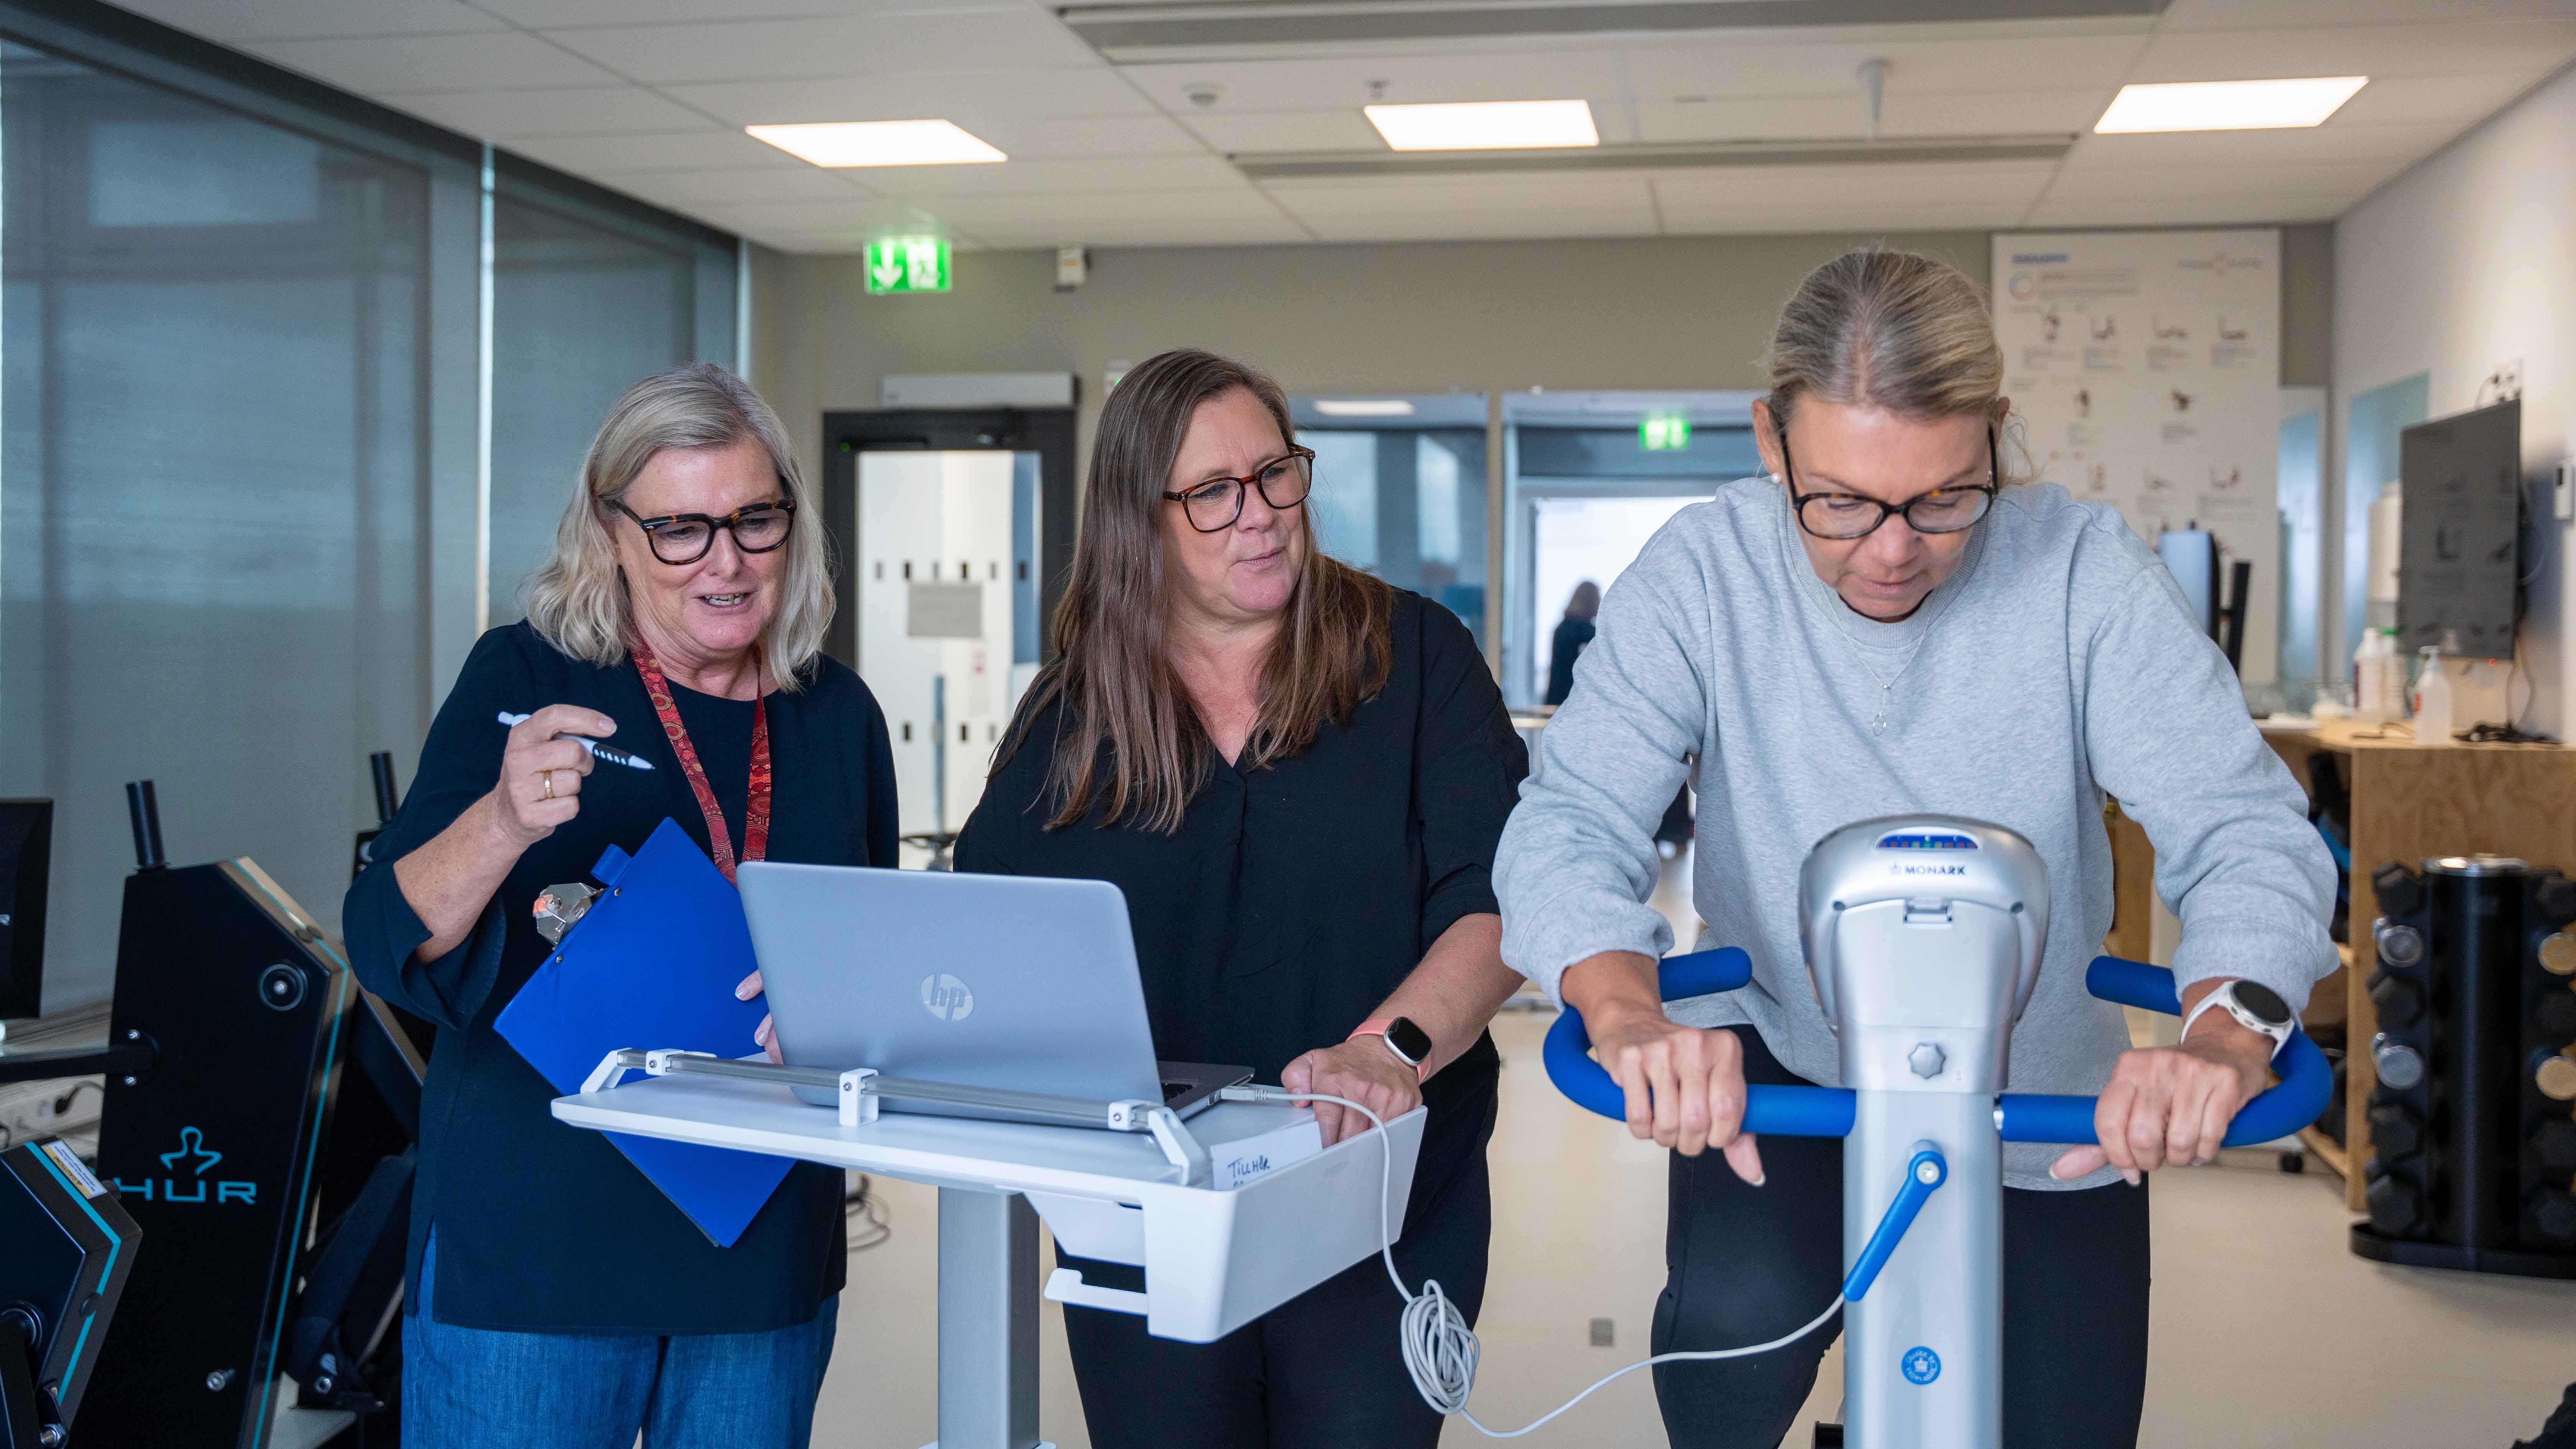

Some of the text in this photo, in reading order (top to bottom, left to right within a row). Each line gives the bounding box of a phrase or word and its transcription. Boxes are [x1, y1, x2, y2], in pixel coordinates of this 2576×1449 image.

[1904, 865, 1966, 875] MONARK
[929, 972, 967, 1021] hp
[112, 1177, 256, 1205] HUR
